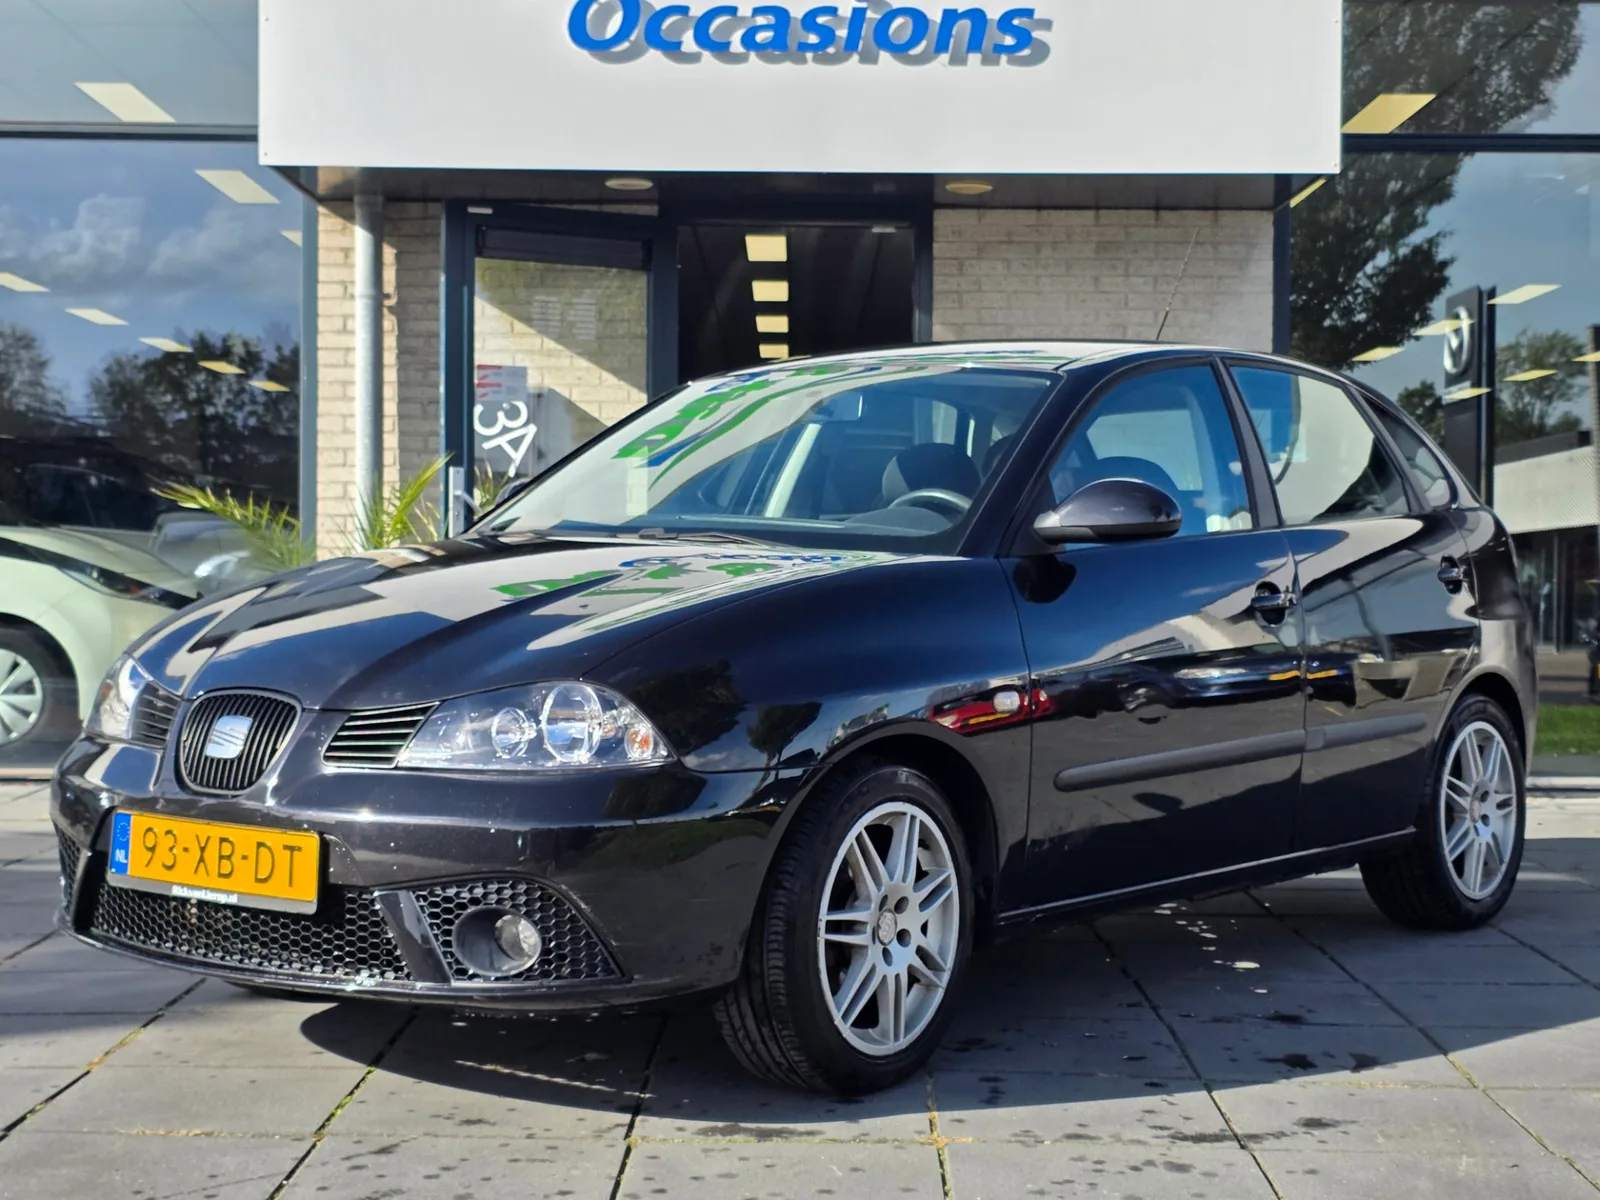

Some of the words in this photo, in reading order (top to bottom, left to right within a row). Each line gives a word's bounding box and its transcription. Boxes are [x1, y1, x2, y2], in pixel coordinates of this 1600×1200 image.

[568, 0, 1036, 54] Occasions
[115, 848, 128, 863] NL
[142, 827, 302, 888] 93-XB-DT
